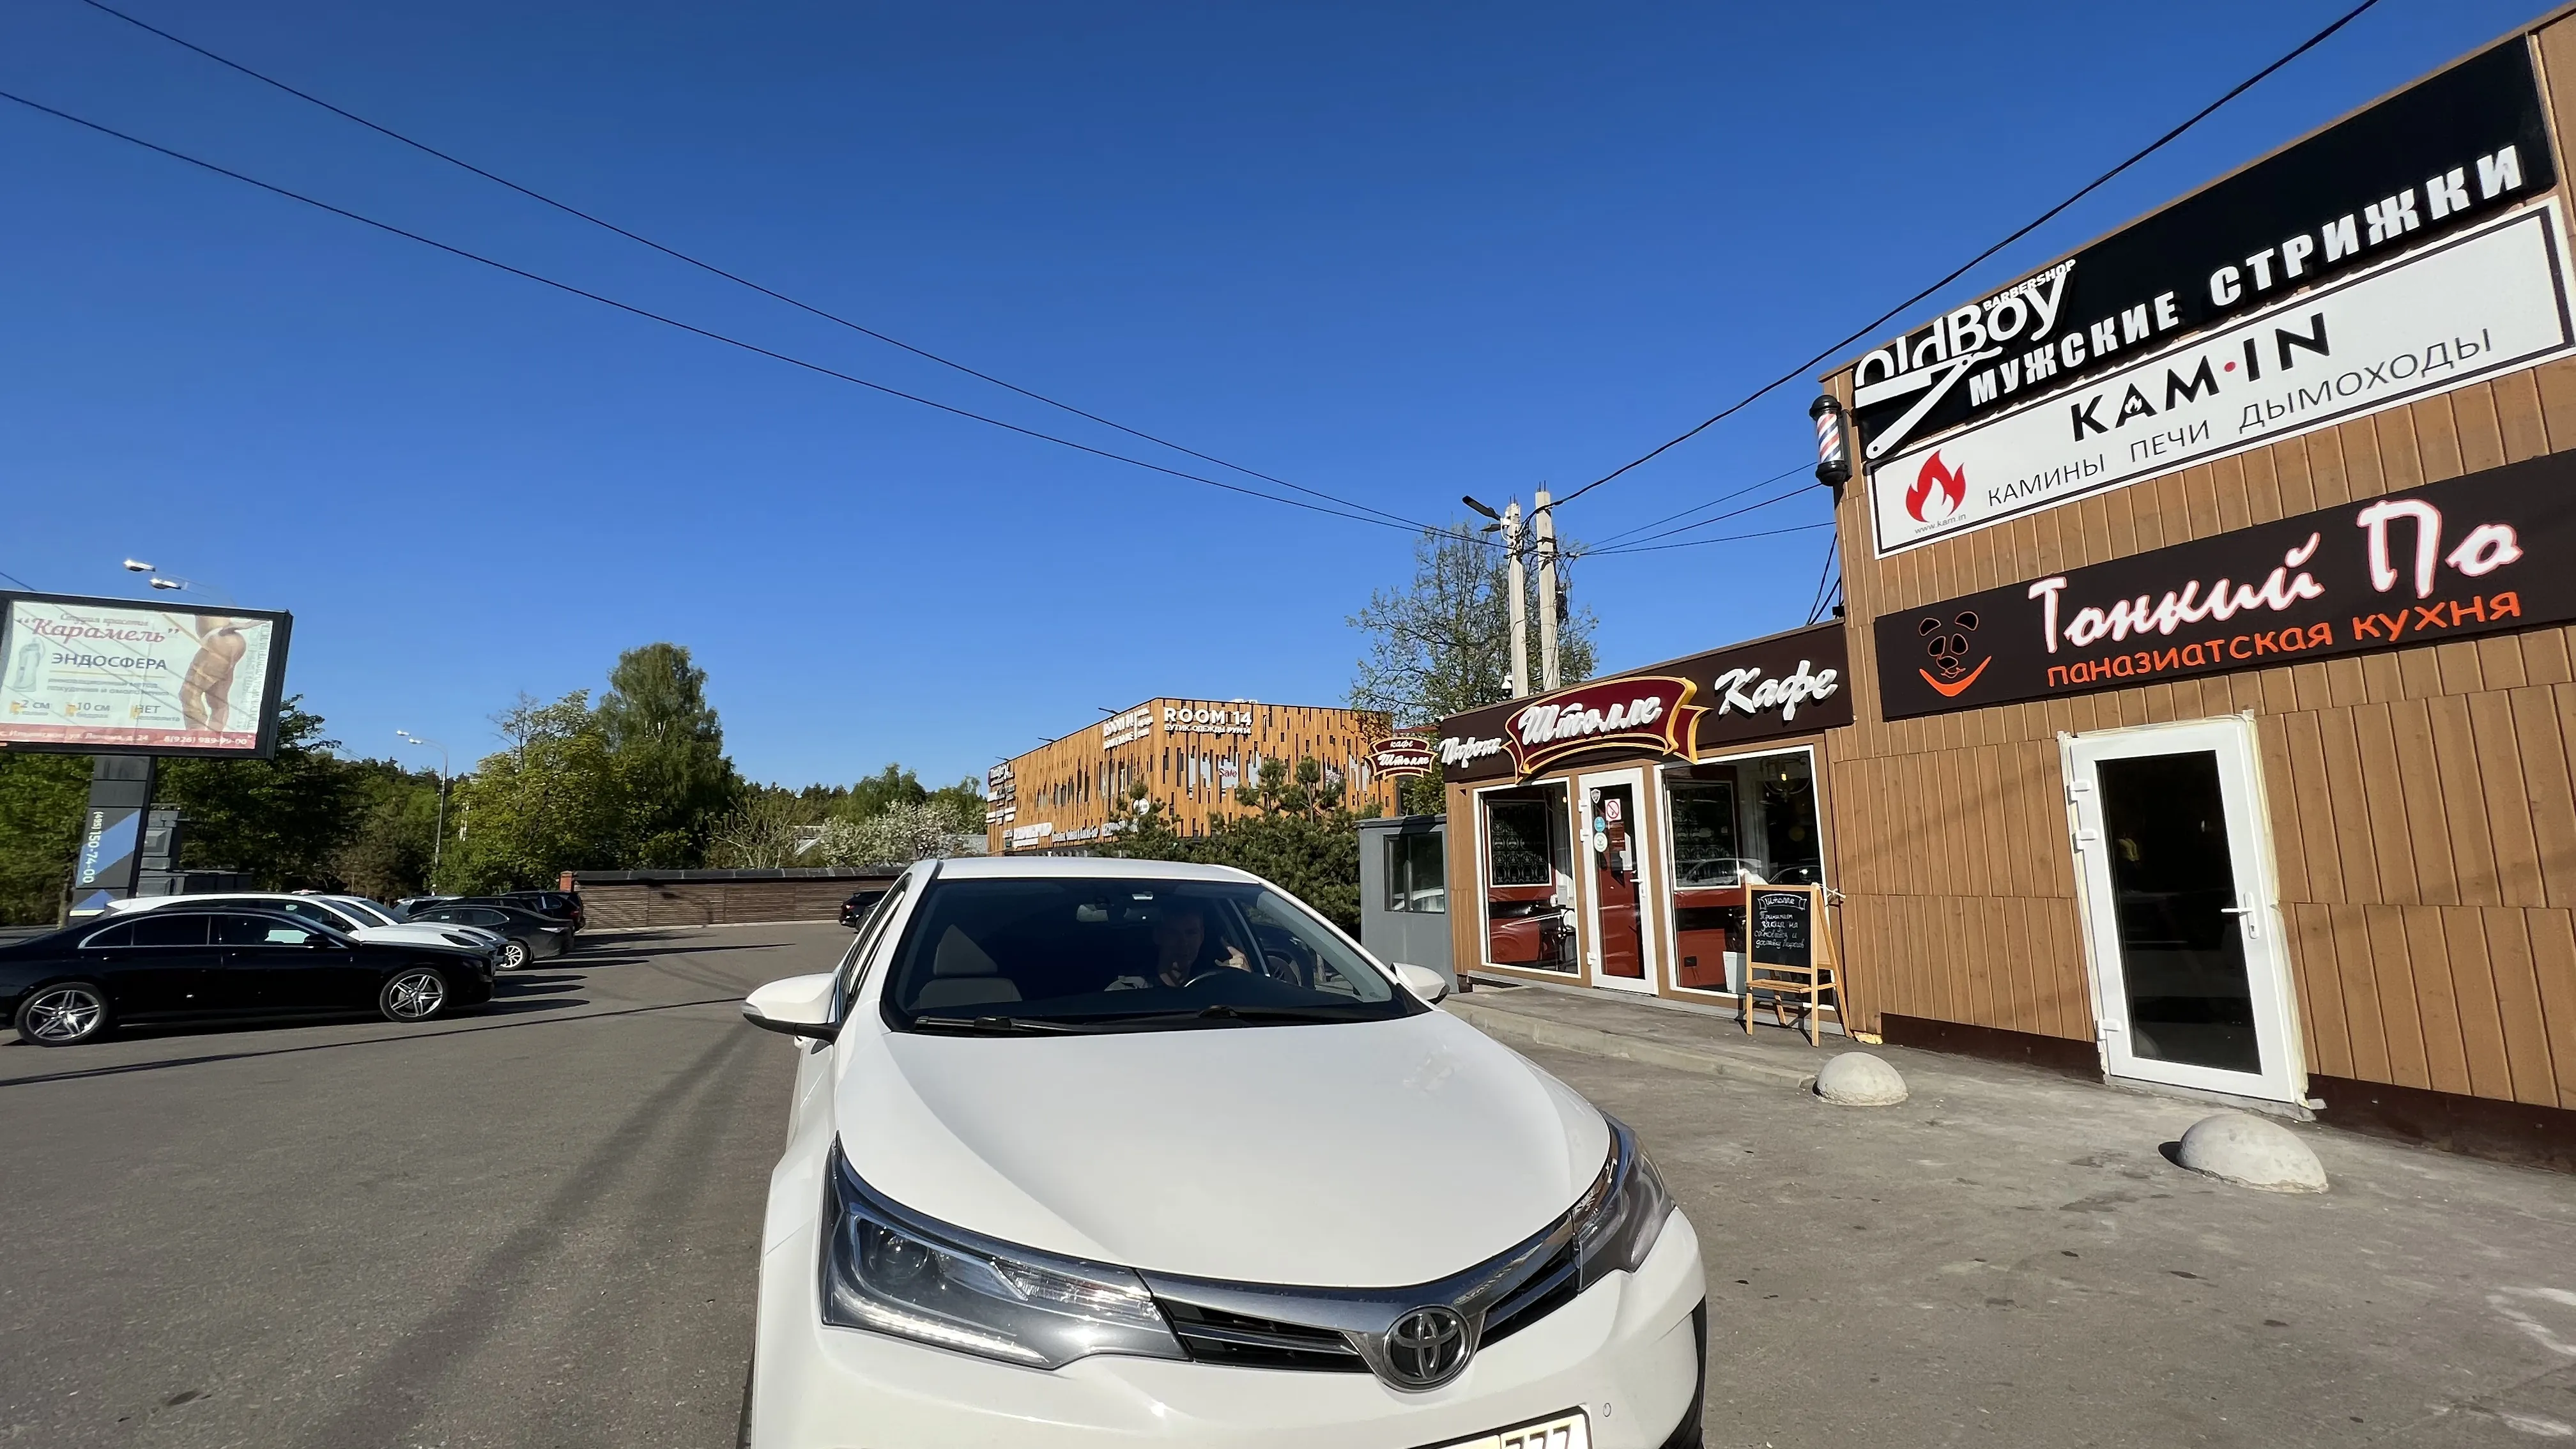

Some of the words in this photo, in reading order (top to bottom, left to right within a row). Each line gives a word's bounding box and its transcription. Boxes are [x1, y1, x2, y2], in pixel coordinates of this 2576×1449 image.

[1968, 289, 2181, 407] МУЖСКИЕ
[2209, 144, 2524, 308] СТРИЖКИ
[1982, 258, 2076, 312] BARBERSHOP
[1988, 454, 2105, 507] КАМИНЫ
[2130, 419, 2211, 464] ПЕЧИ
[2239, 326, 2493, 435] ДЫМОХОДЫ
[1914, 512, 1967, 534] www.kam.in
[2027, 532, 2326, 654] Тонкий
[2356, 498, 2524, 599] По
[52, 652, 168, 670] ЭНДОСФЕРА
[2047, 622, 2334, 687] паназиатская
[1714, 659, 1839, 721] Кафе
[135, 705, 161, 714] НЕТ
[1164, 707, 1225, 724] ROOM
[1233, 710, 1252, 726] 14
[1517, 695, 1663, 746] Штолле
[1192, 725, 1225, 733] ОДЕЖДЫ
[1390, 739, 1414, 749] кафе
[1377, 753, 1430, 766] Штолле
[1218, 767, 1238, 778] Sale
